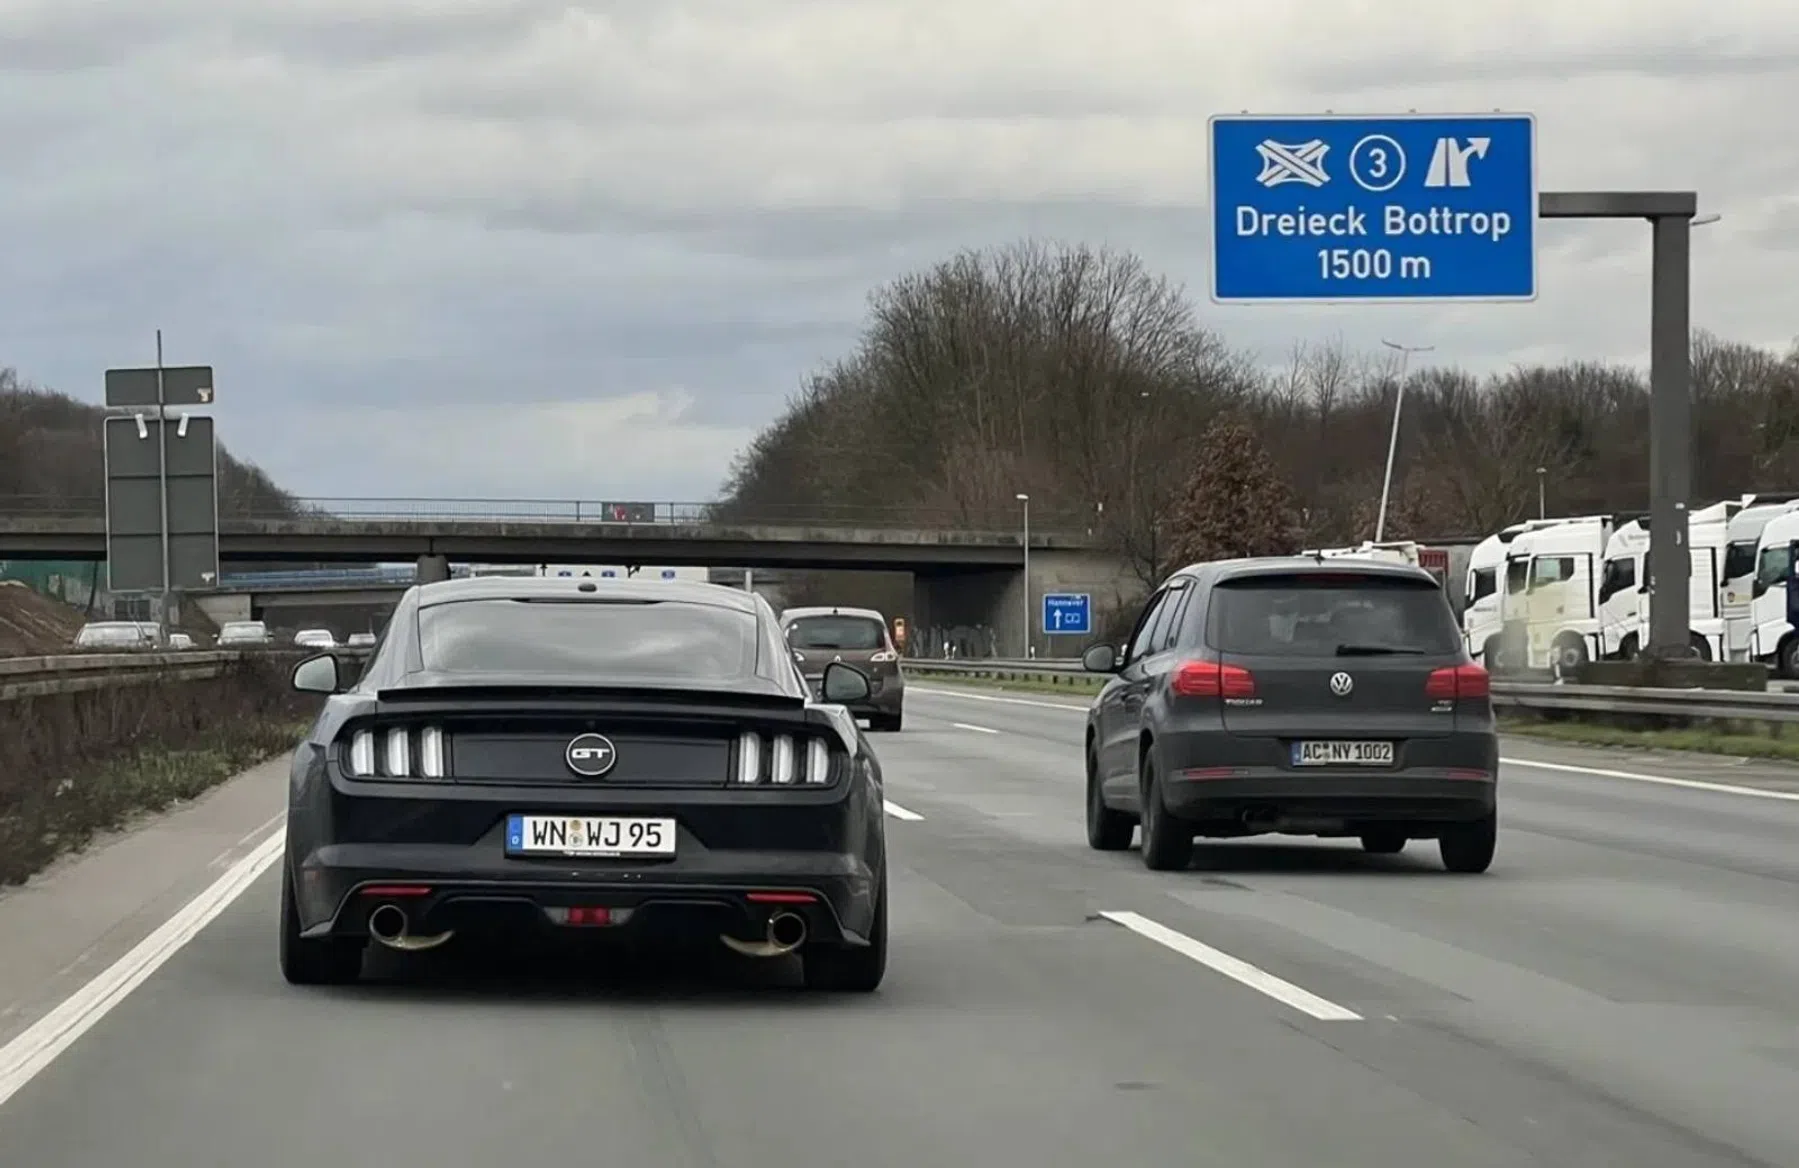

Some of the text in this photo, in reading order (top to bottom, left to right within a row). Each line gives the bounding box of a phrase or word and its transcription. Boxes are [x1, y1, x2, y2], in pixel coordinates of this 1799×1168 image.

[1369, 148, 1387, 178] 3
[1236, 205, 1511, 242] Dreieck Bottrop
[1318, 249, 1431, 279] 1500 m
[572, 748, 611, 759] GT
[1303, 743, 1391, 760] AC NY 1002
[532, 820, 662, 848] WN WJ 95
